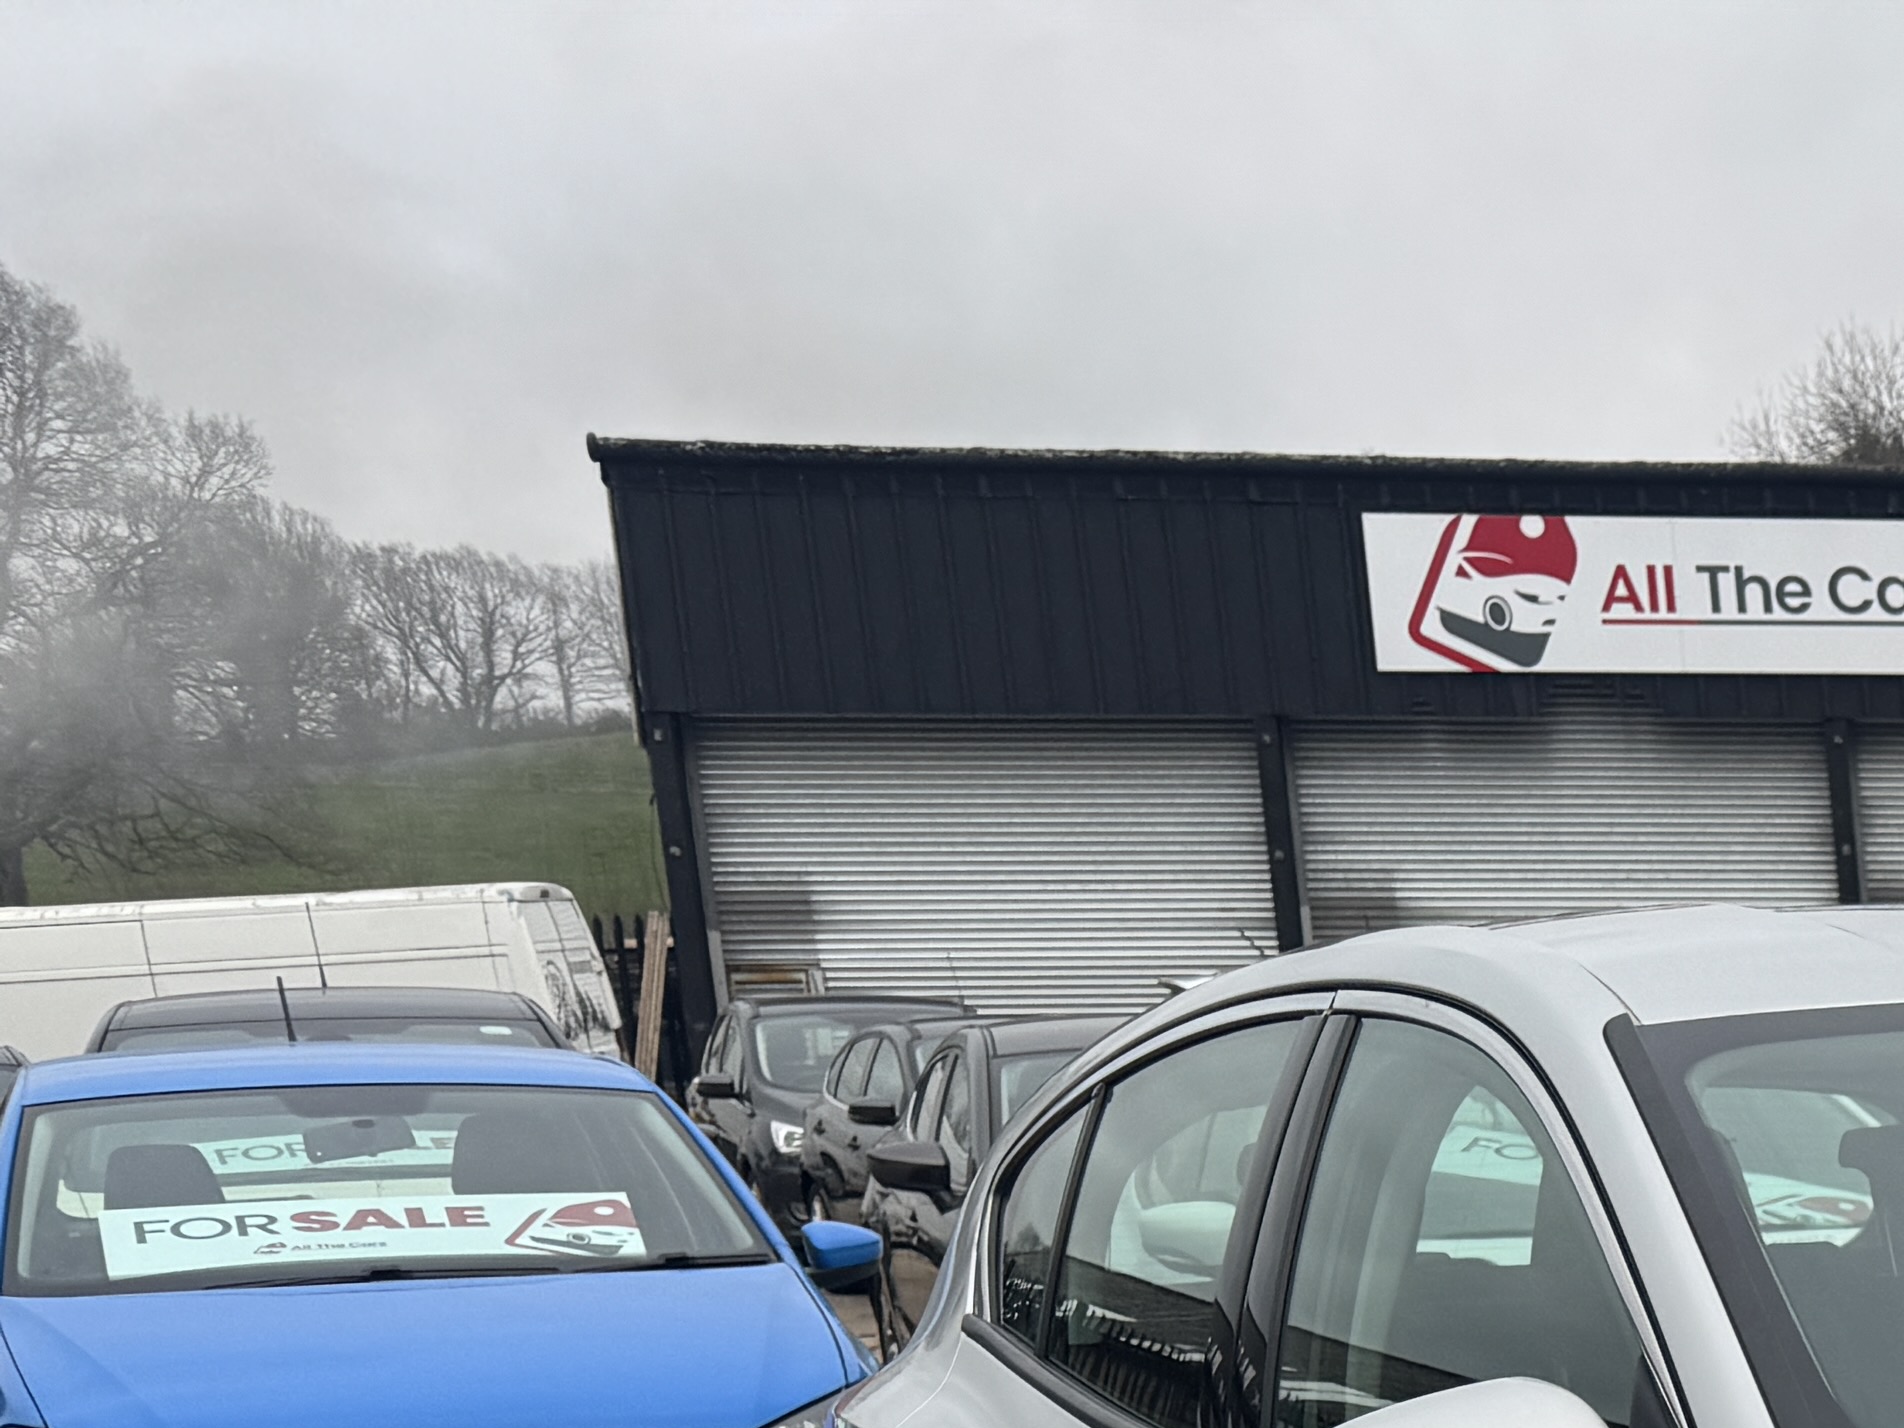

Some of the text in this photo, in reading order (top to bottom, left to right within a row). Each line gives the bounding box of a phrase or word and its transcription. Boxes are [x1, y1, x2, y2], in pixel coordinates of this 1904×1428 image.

[1600, 564, 1677, 614] All
[1695, 564, 1812, 615] The
[133, 1205, 490, 1245] FOR SALE
